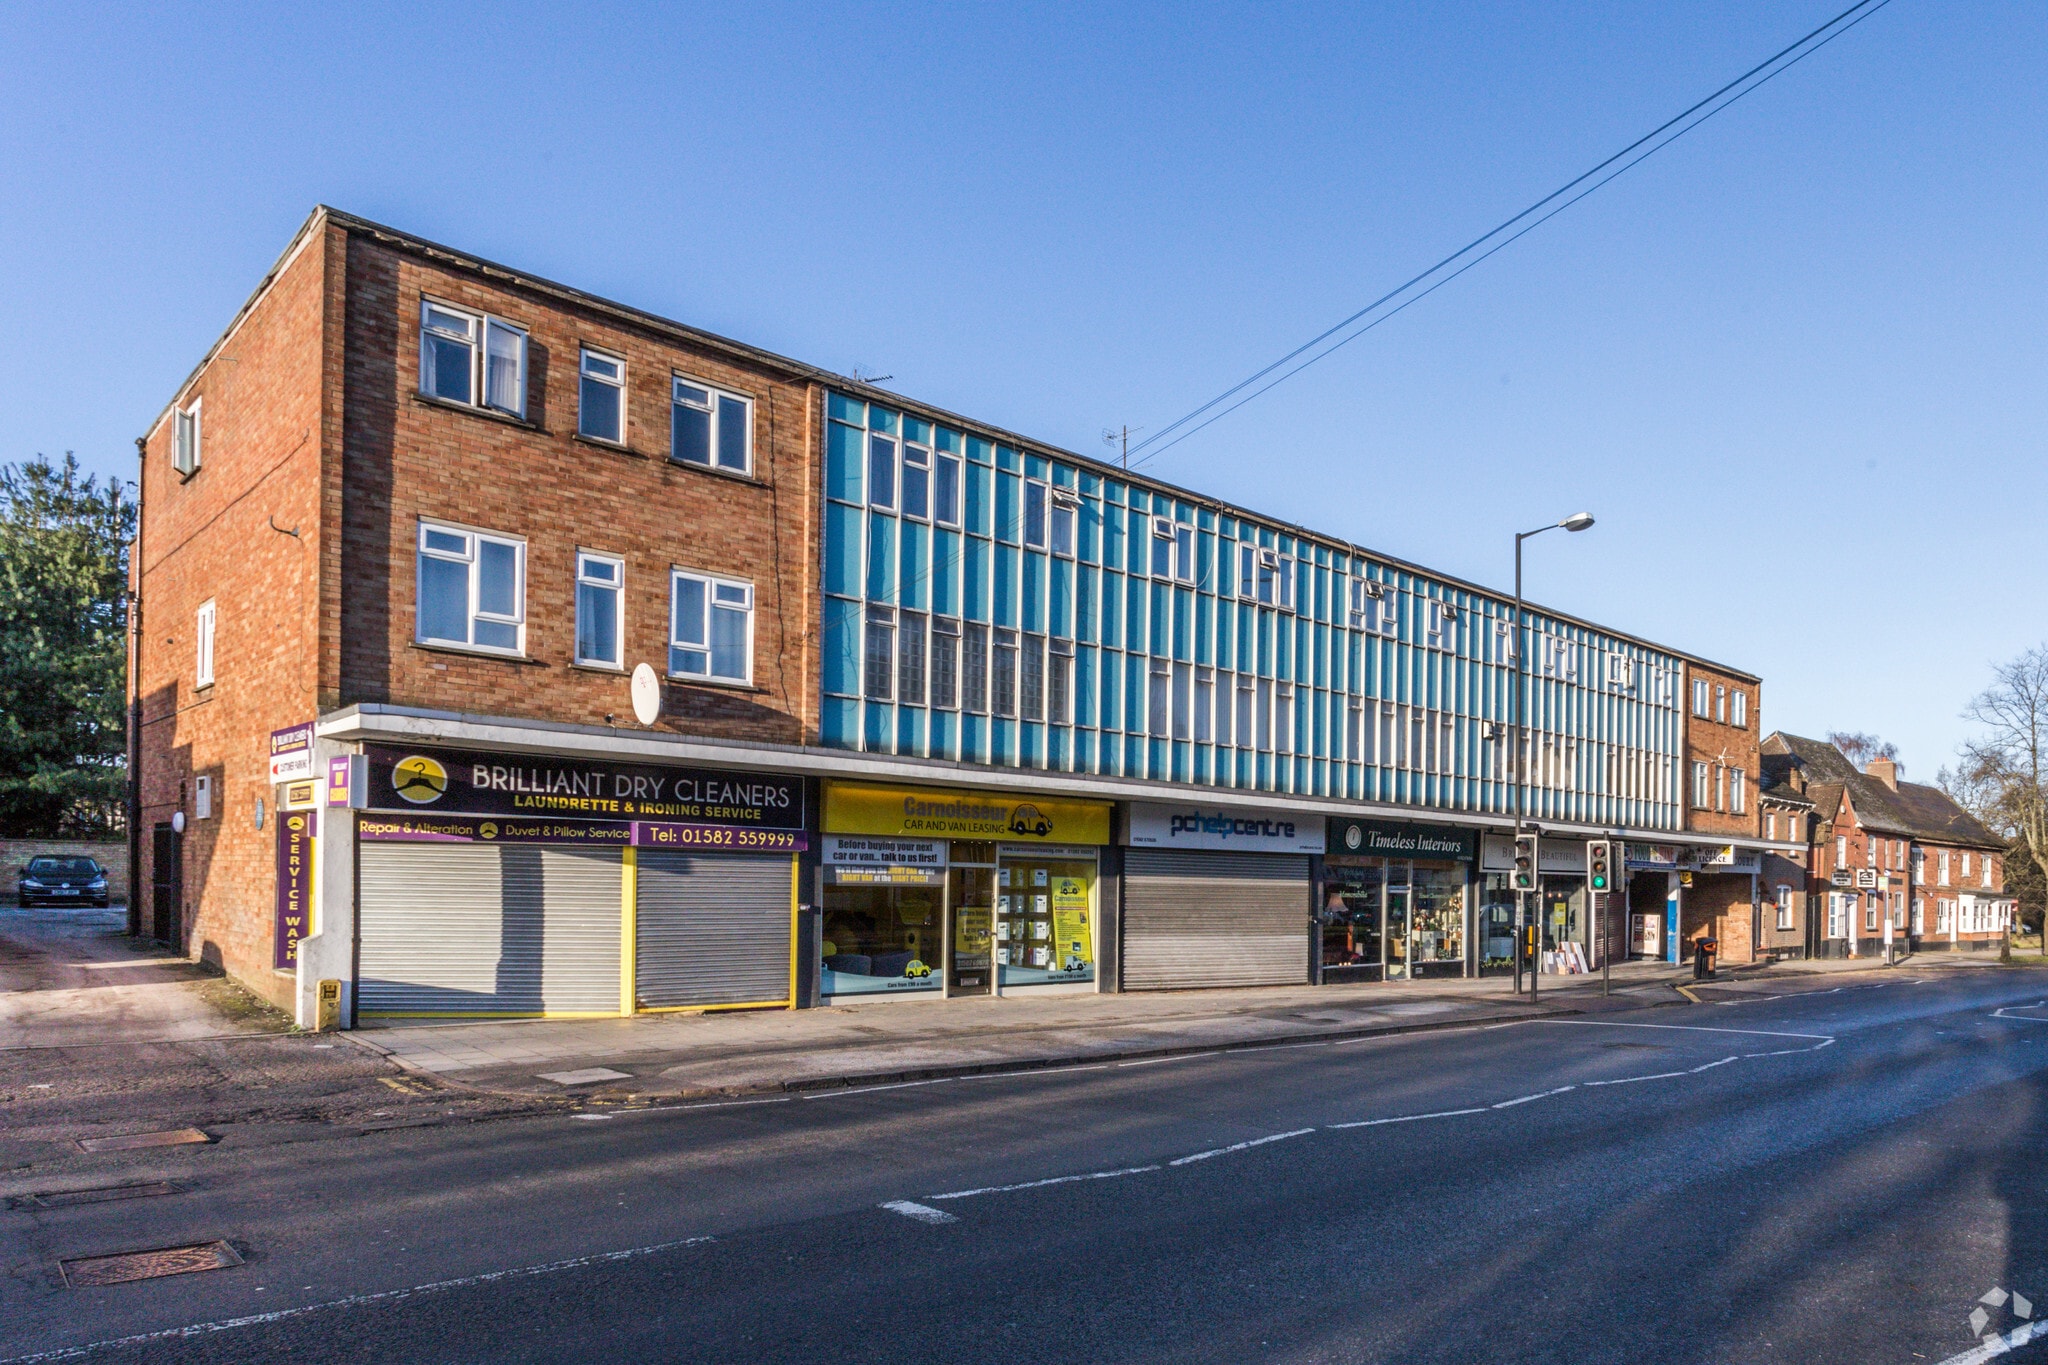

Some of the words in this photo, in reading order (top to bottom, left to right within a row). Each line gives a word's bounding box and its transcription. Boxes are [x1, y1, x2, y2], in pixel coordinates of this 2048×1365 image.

[473, 764, 604, 796] BRILLIANT
[615, 774, 665, 800] DRY
[675, 779, 790, 808] CLEANERS
[514, 795, 619, 812] LAUNDRETTE
[624, 802, 635, 813] &
[640, 802, 701, 816] IRONING
[705, 806, 761, 820] SERVICE
[903, 796, 1008, 822] Carnoisseur
[360, 820, 400, 836] Repair
[403, 822, 412, 834] &
[414, 822, 473, 835] Alteration
[506, 825, 541, 836] Duvet
[543, 827, 551, 837] &
[554, 827, 586, 838] Pillow
[588, 828, 630, 839] Service
[904, 819, 923, 830] CAR
[926, 820, 946, 831] AND
[947, 821, 966, 832] VAN
[969, 822, 1005, 834] LEASING
[1171, 811, 1295, 839] pchelpcentre
[650, 828, 677, 842] Tel:
[682, 829, 732, 845] 01582
[738, 831, 795, 847] 559999
[838, 839, 866, 850] Before
[868, 840, 896, 852] buying
[897, 842, 915, 852] your
[916, 842, 933, 852] next
[1368, 830, 1416, 850] Timeless
[1417, 834, 1461, 853] Interiors
[833, 851, 847, 860] car
[849, 852, 858, 861] or
[881, 852, 896, 862] talk
[898, 853, 906, 862] to
[907, 853, 917, 863] us
[918, 853, 937, 863] first!
[1541, 849, 1577, 862] BEAUTIFUL
[1698, 855, 1726, 863] LICENCE
[289, 833, 301, 910] SERVICE
[881, 874, 892, 882] the
[285, 916, 301, 960] WASH
